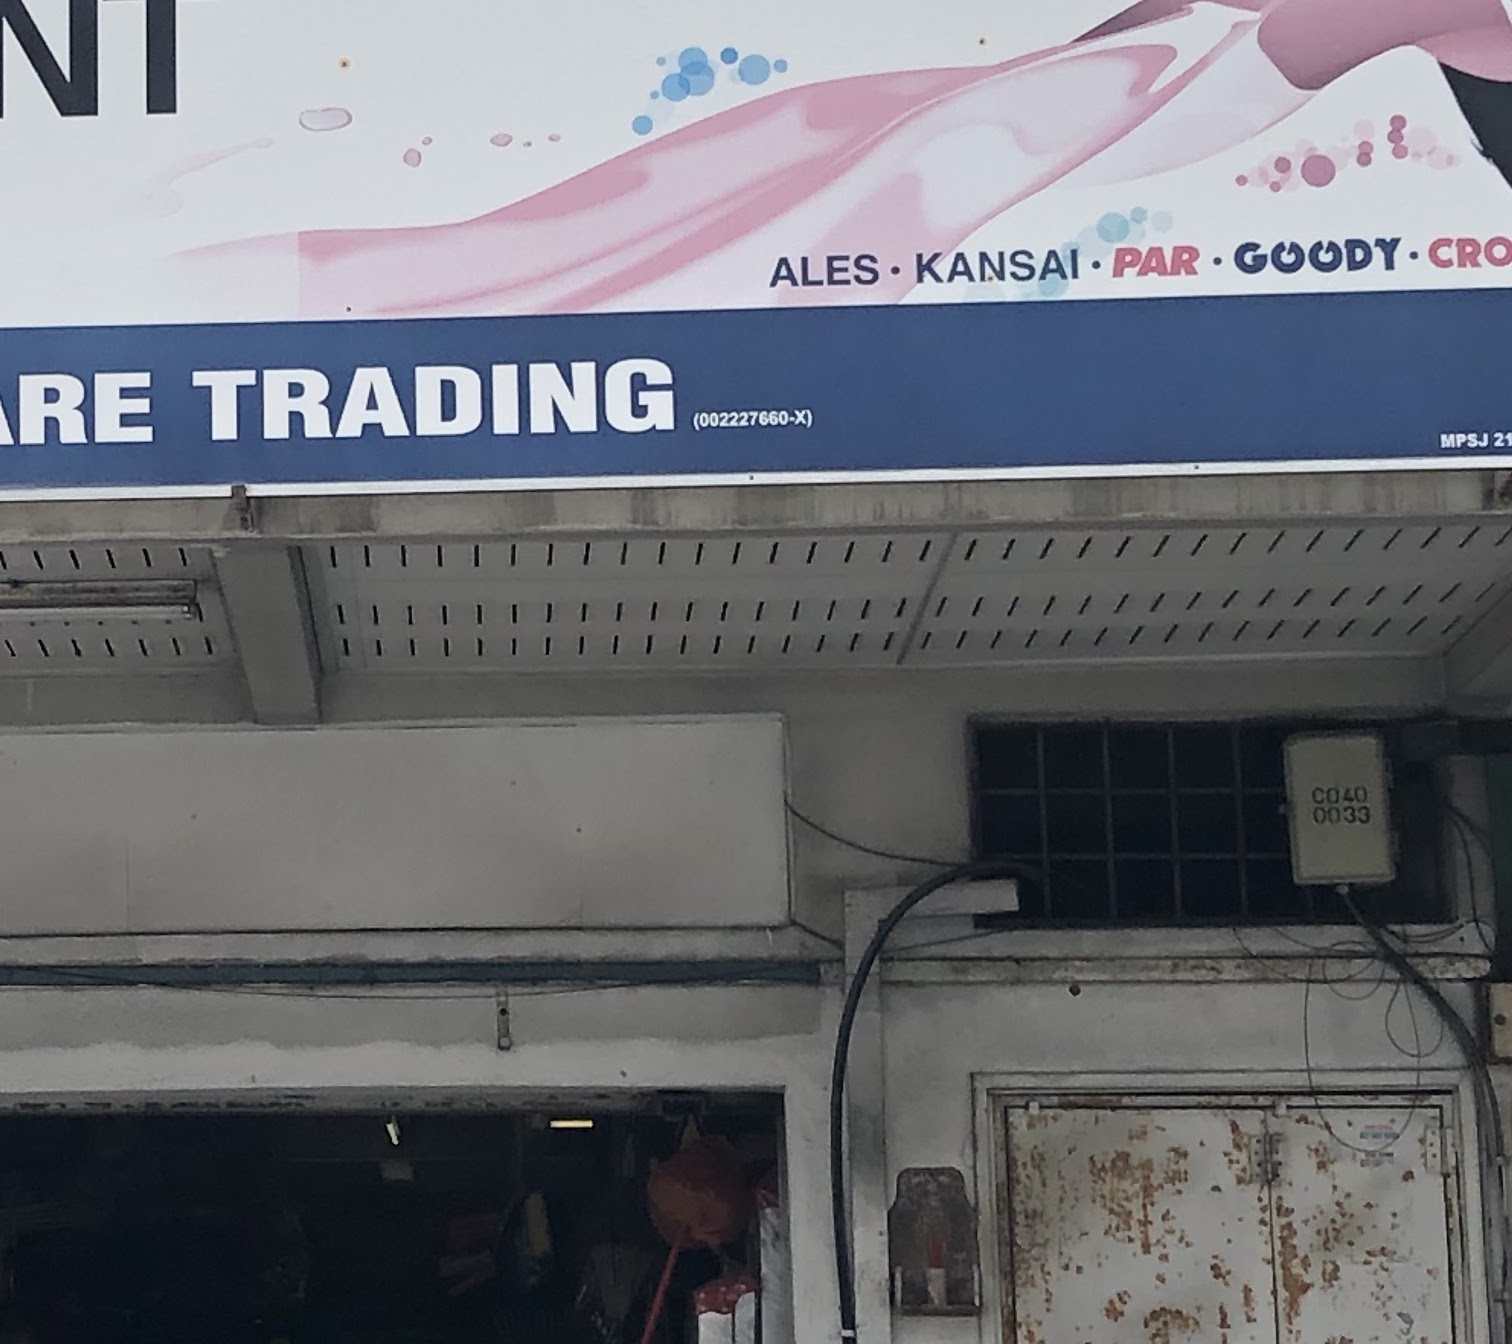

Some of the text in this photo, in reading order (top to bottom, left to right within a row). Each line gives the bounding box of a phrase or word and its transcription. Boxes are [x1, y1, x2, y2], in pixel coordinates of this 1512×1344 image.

[769, 236, 1512, 289] ALES KANSAI PAR GOODY CRO
[192, 358, 676, 441] TRADING
[693, 408, 814, 431] (002227660-X)
[1440, 433, 1489, 448] MPSJ
